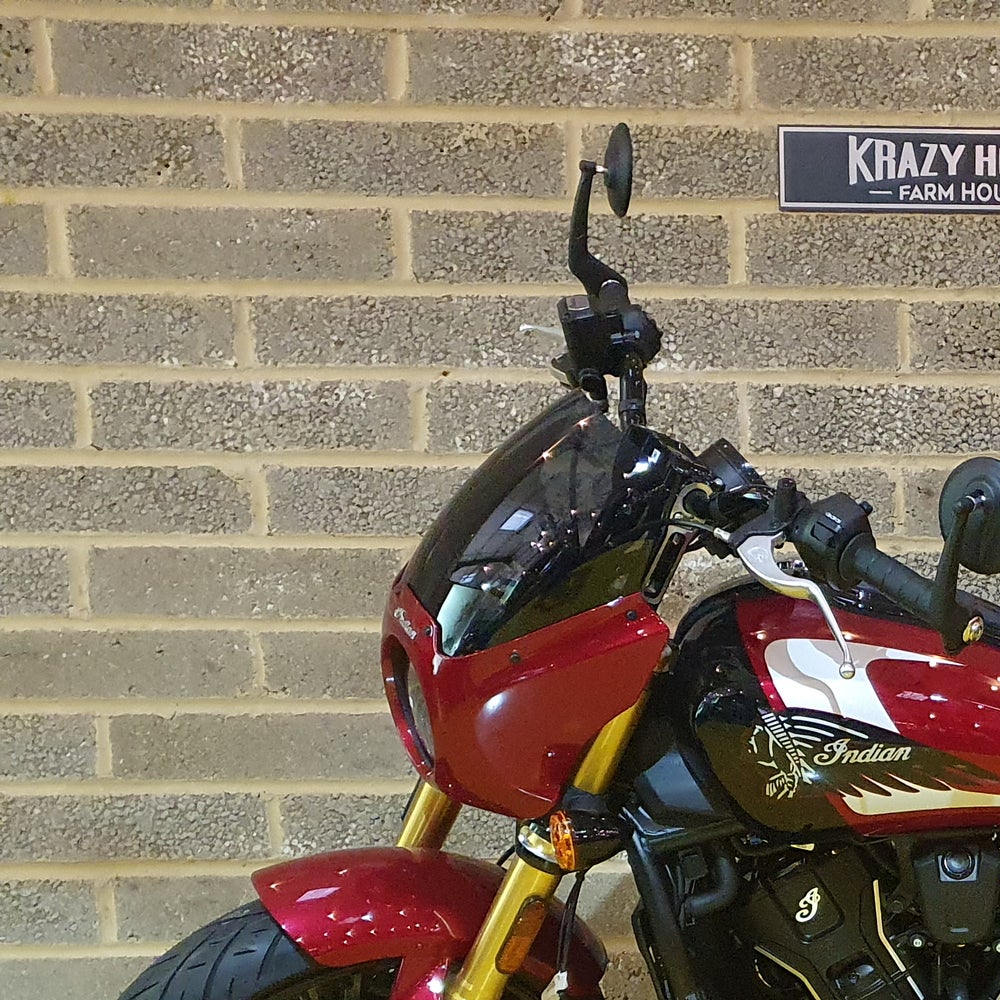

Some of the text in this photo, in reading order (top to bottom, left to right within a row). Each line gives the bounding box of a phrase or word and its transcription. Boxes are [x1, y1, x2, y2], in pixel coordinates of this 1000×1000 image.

[848, 134, 966, 186] KRAZY
[899, 182, 954, 202] FARM
[813, 738, 912, 766] Indian
